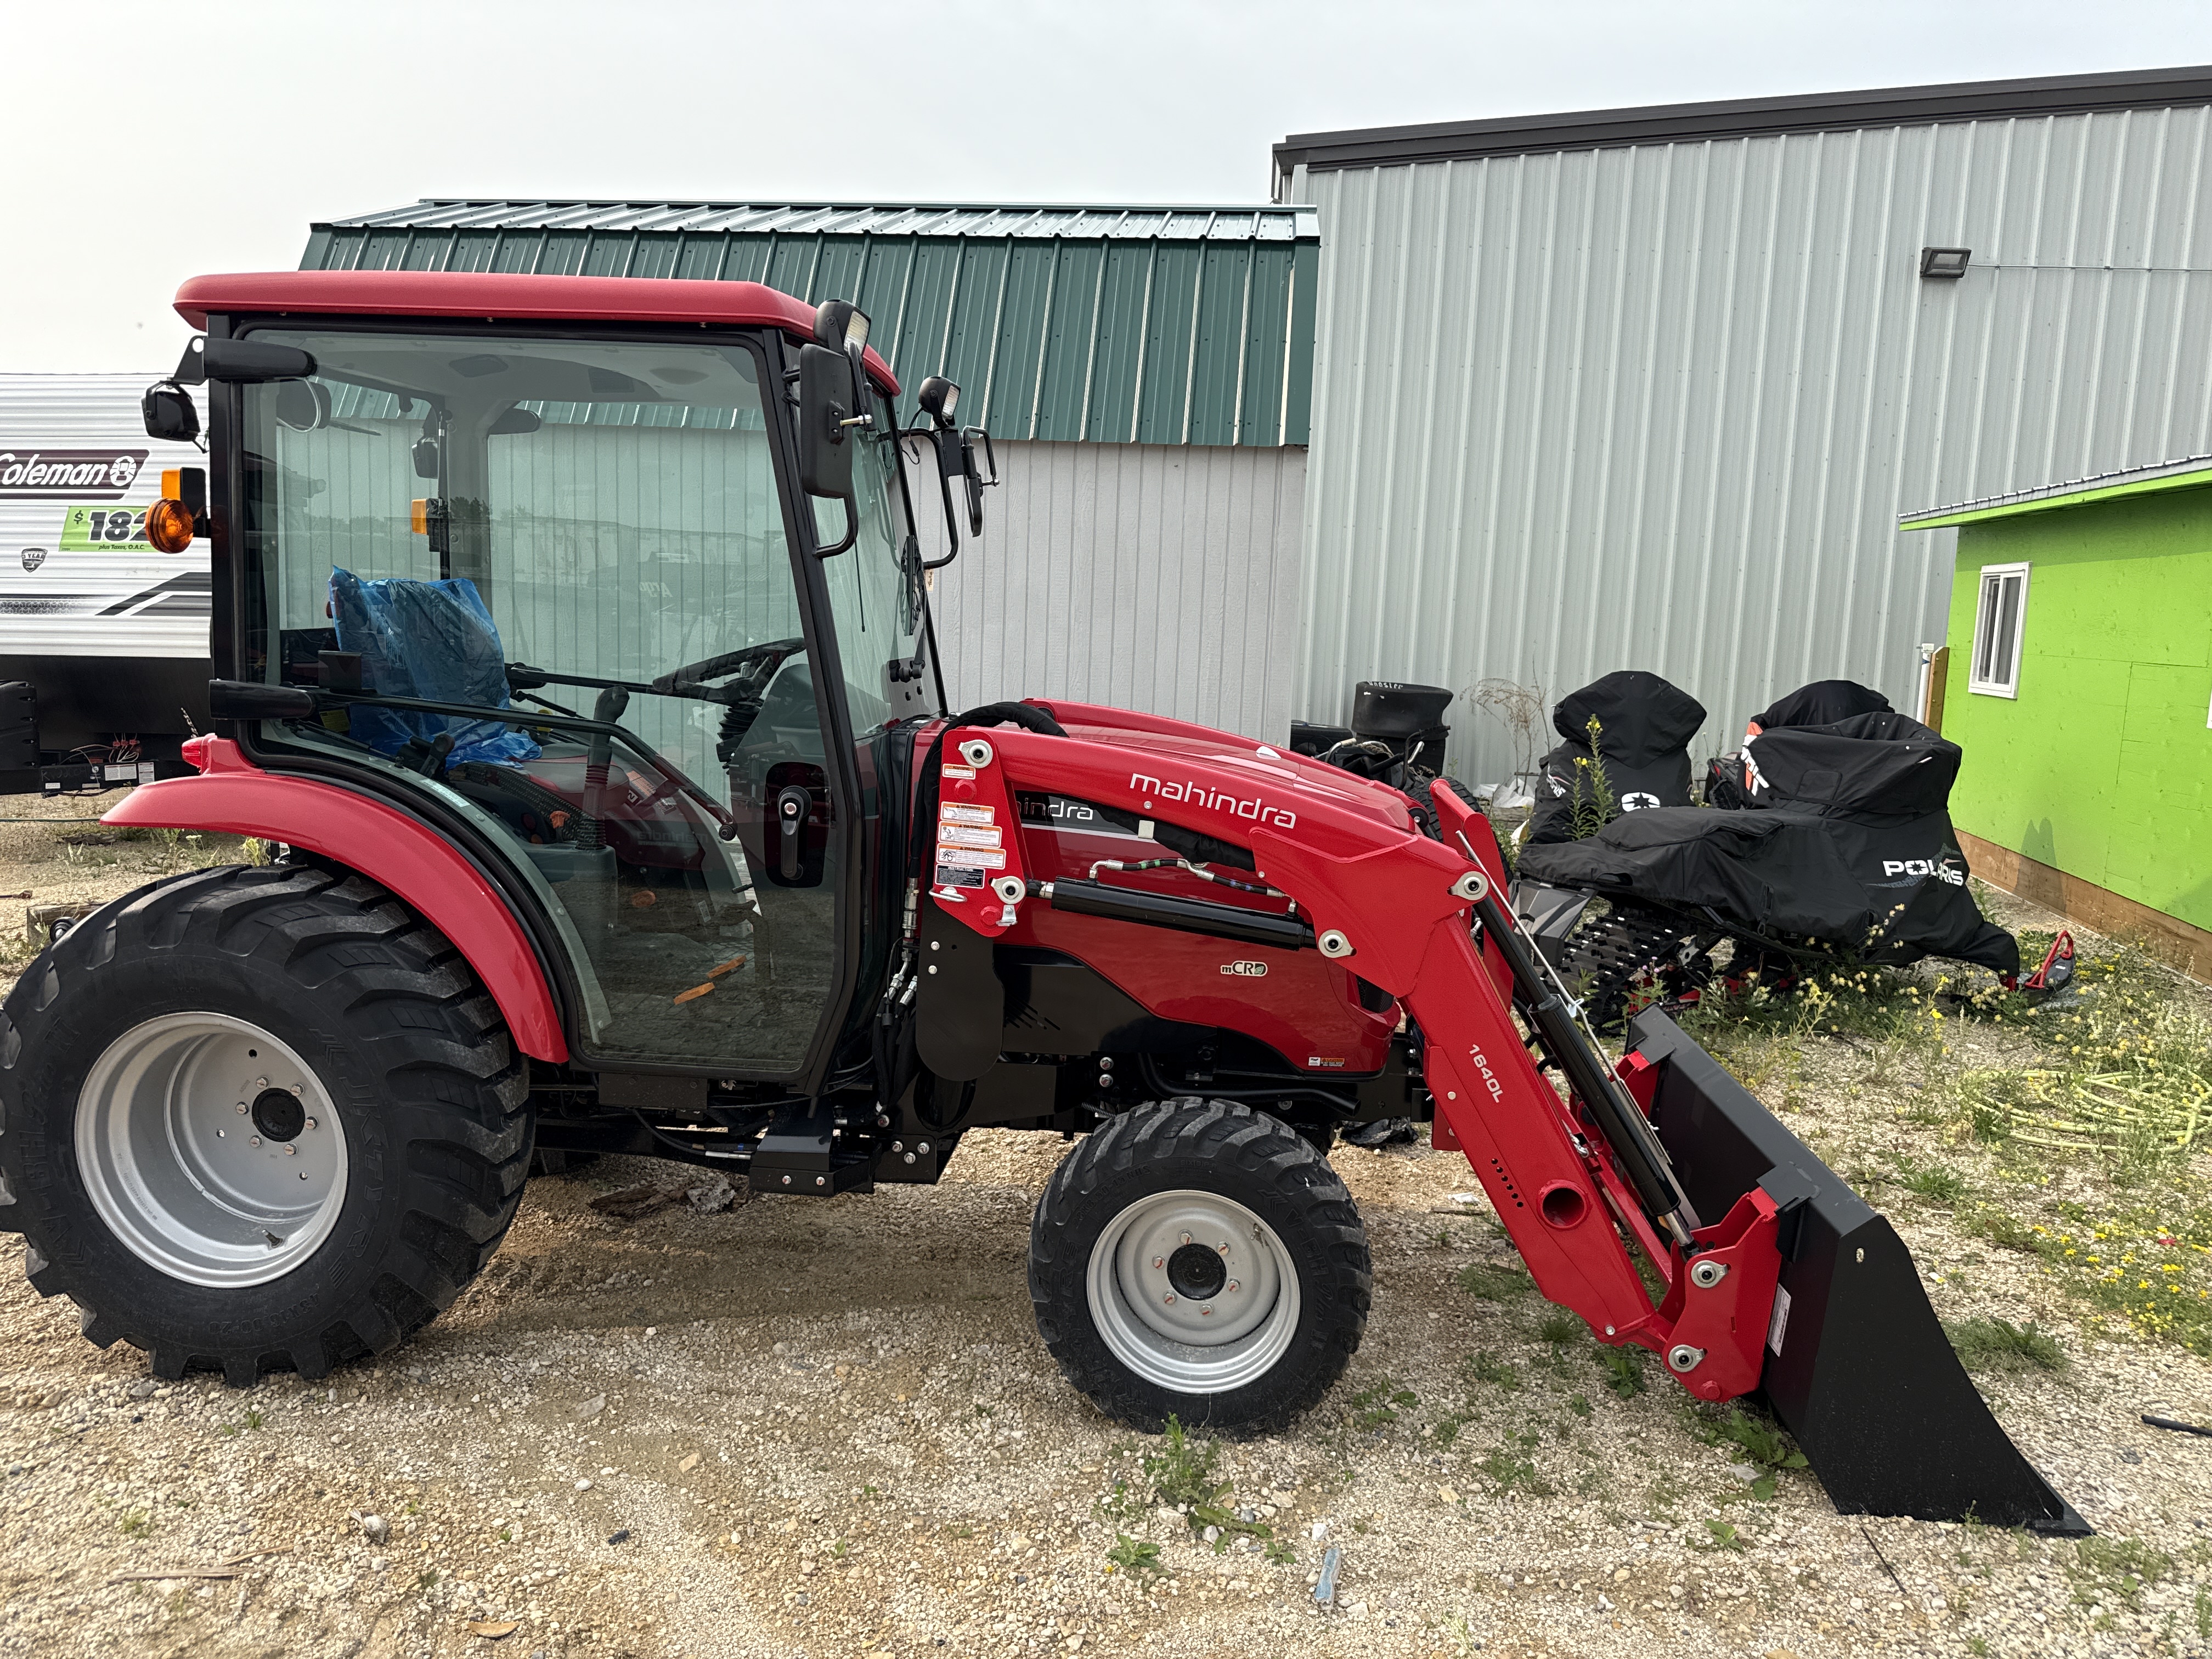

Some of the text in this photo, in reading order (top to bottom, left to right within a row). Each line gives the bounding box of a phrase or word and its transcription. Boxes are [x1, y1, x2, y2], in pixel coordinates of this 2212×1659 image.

[1130, 772, 1296, 830] mahindra
[1883, 860, 1963, 887] POLARIS
[1469, 1043, 1503, 1103] 1640L
